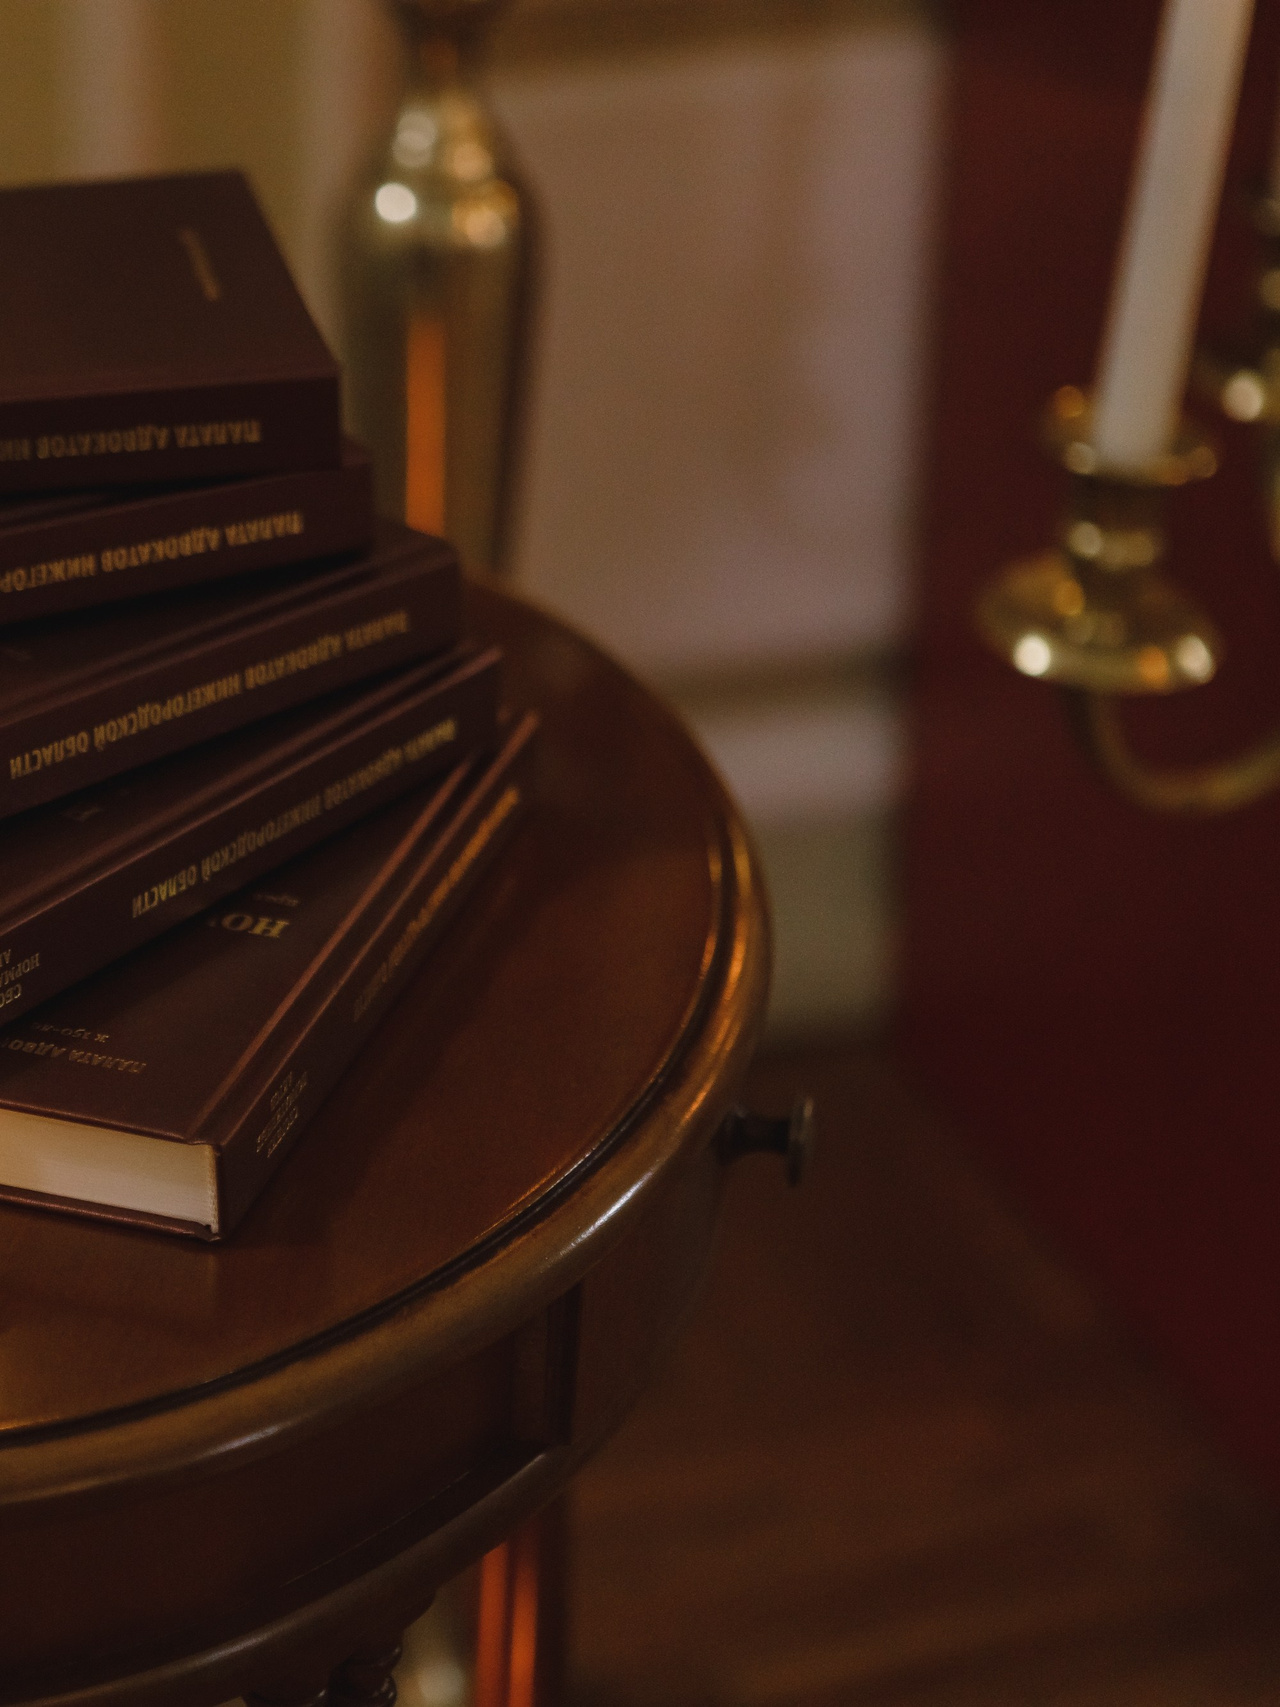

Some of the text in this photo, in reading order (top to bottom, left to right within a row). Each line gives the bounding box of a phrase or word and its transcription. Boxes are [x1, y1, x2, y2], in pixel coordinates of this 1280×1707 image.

[36, 424, 169, 459] АДВОКАТОВ
[174, 418, 261, 448] ПАЛАТА
[101, 525, 220, 572] АДВОКАТОВ
[225, 511, 304, 546] ПАЛАТА
[93, 672, 241, 751] НИЖЕГОРОДСКОЙ
[9, 731, 90, 779] ОБЛАСТИ
[132, 864, 198, 919] ОБЛАСТИ
[69, 1049, 147, 1073] ПАЛАТА
